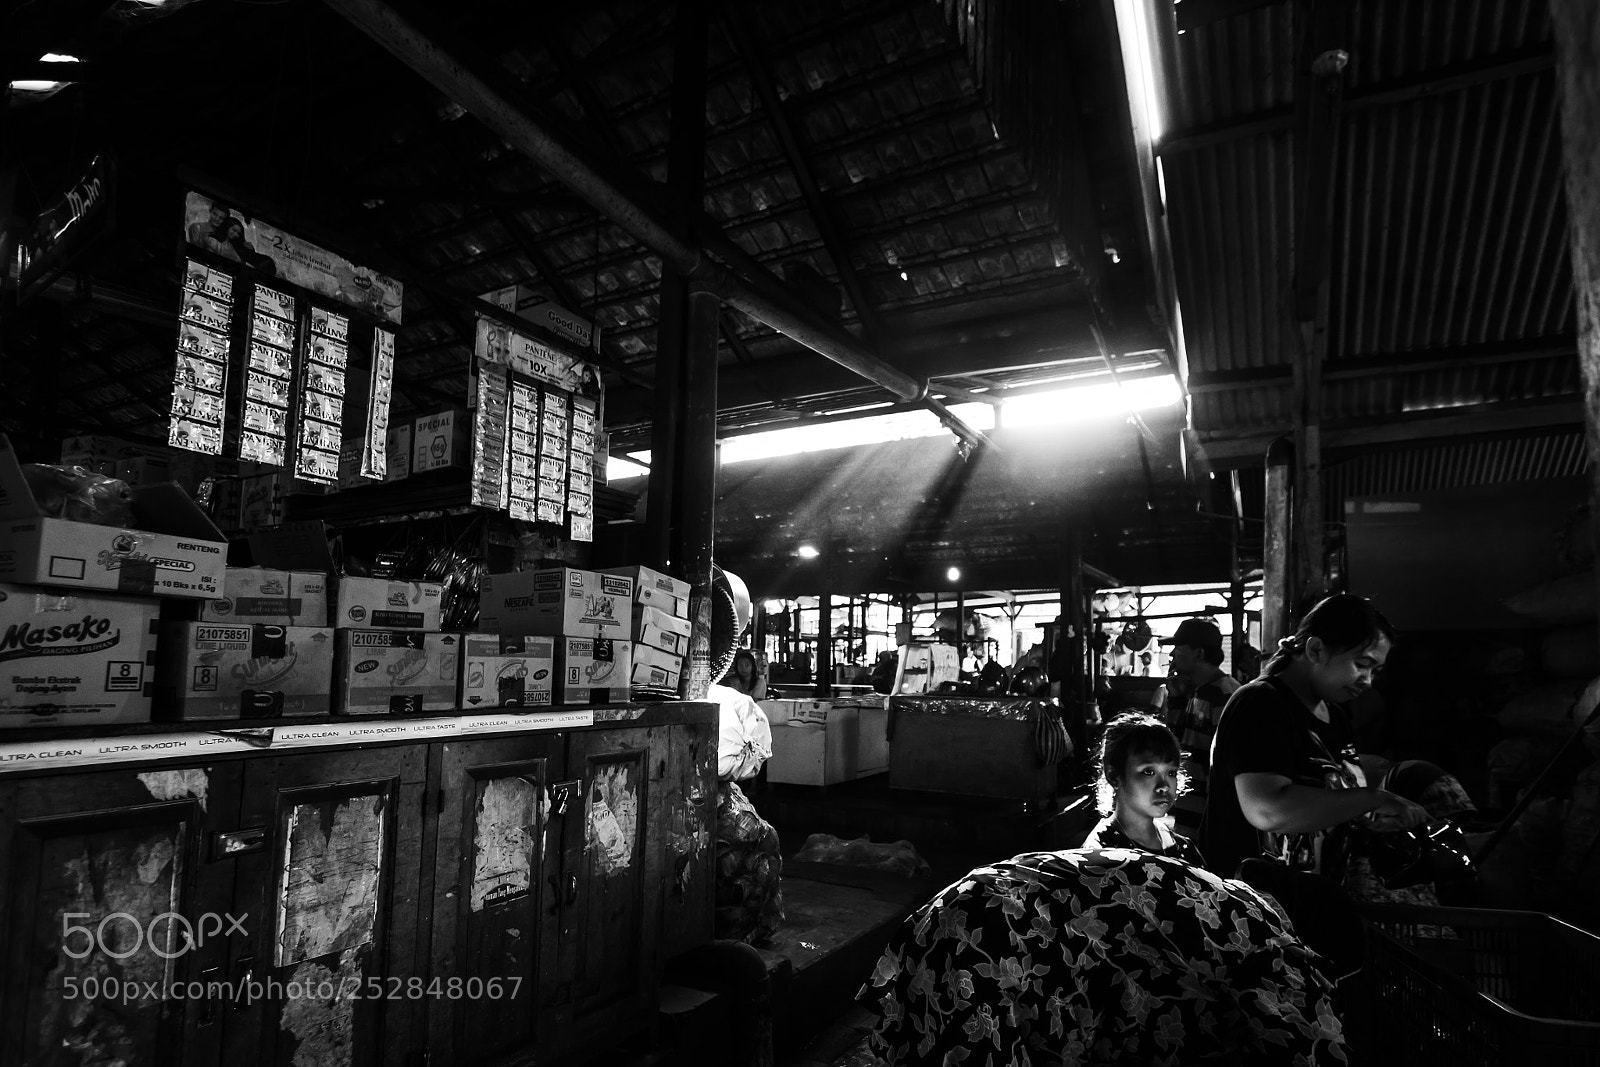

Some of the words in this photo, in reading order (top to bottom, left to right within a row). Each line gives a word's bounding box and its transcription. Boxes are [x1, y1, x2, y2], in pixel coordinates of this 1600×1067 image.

[255, 286, 295, 304] PANTENE
[547, 311, 573, 331] Good
[525, 343, 558, 362] PANTENE
[530, 361, 548, 375] 10X
[418, 418, 450, 432] SPECIAL
[177, 542, 220, 554] RENTENG
[154, 558, 190, 569] SPECIAL
[162, 580, 172, 588] 10
[0, 615, 111, 652] Masako
[198, 628, 248, 640] 21075851
[354, 633, 393, 645] 2107585
[42, 646, 78, 655] DAGING
[80, 640, 115, 652] PILIHAN
[195, 642, 217, 650] LIME
[218, 643, 247, 651] LIQUID
[119, 663, 132, 677] 8
[358, 660, 376, 672] NEW
[200, 668, 211, 684] 8
[571, 669, 577, 680] 8
[524, 692, 550, 702] 2107585
[376, 726, 406, 734] SMOOTH
[413, 724, 436, 732] ULTRA
[99, 745, 138, 754] ULTRA
[141, 741, 187, 750] SMOOTH
[199, 737, 232, 746] ULTRA
[0, 753, 37, 762] LTRA
[39, 749, 82, 759] CLEAN
